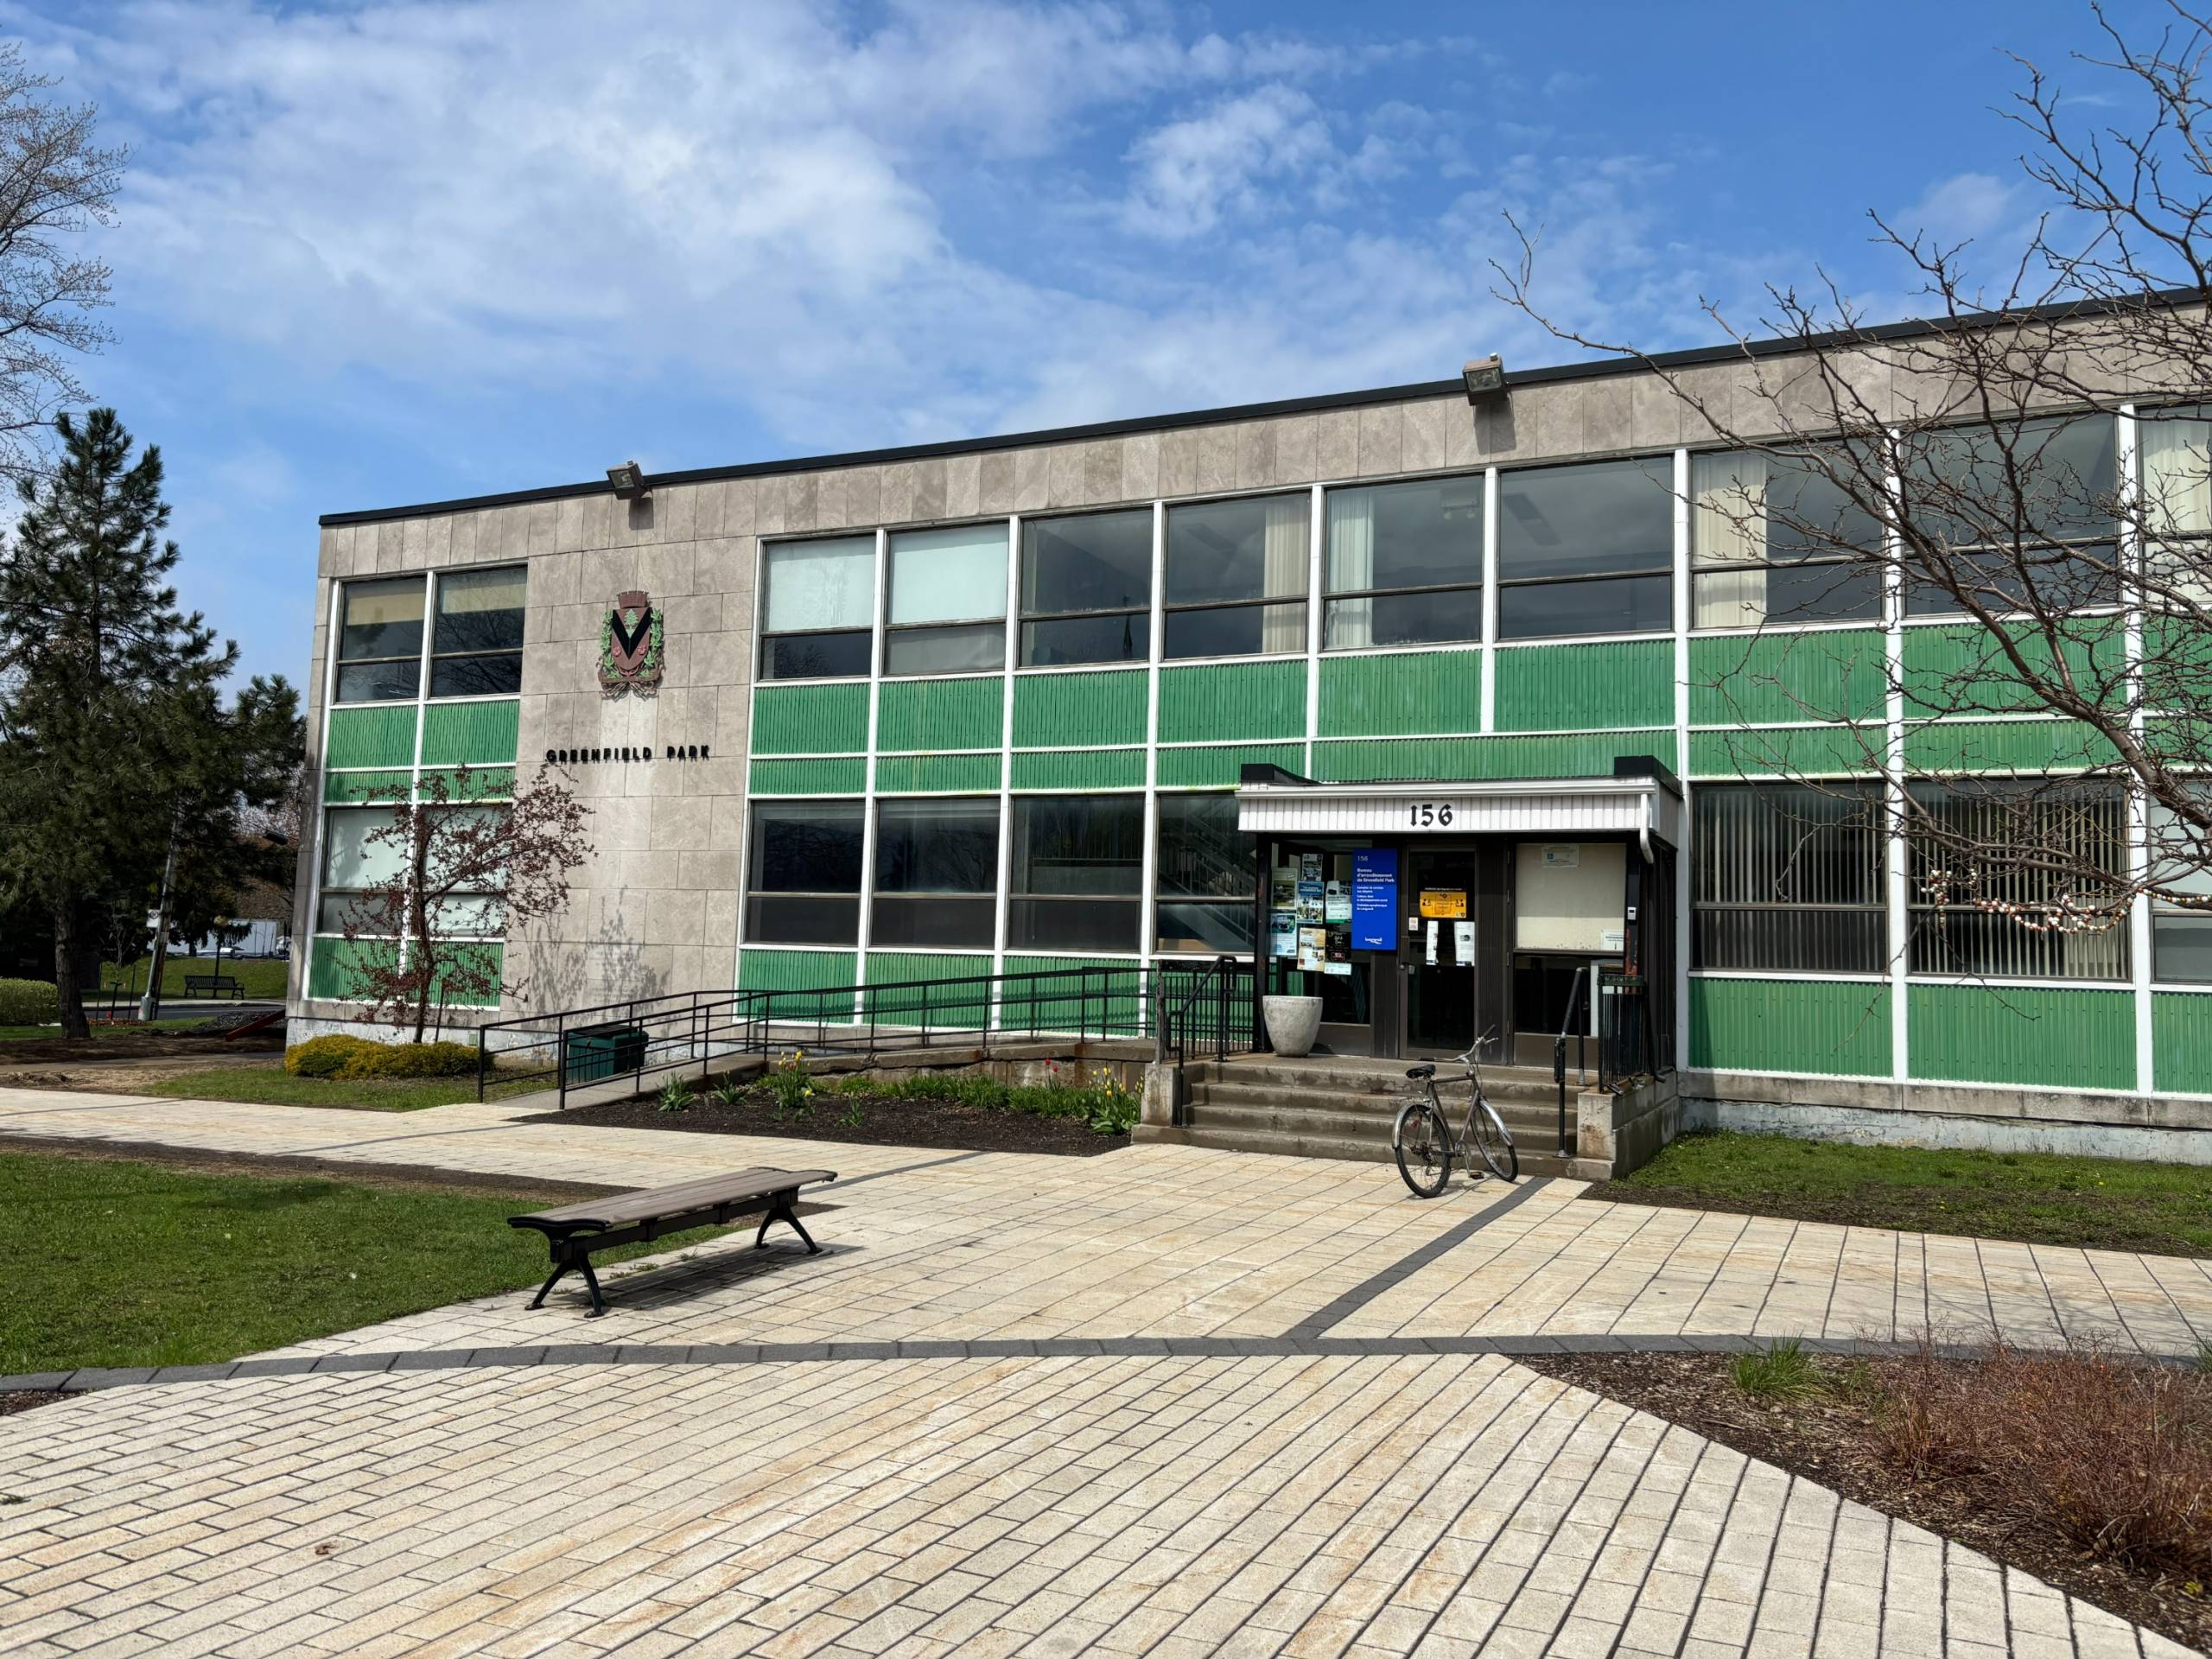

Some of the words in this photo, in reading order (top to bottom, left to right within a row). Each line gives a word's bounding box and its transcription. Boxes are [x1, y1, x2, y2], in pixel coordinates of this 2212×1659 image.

[545, 747, 652, 765] GREENFIELD
[666, 745, 710, 761] PARK
[1409, 804, 1453, 827] 156
